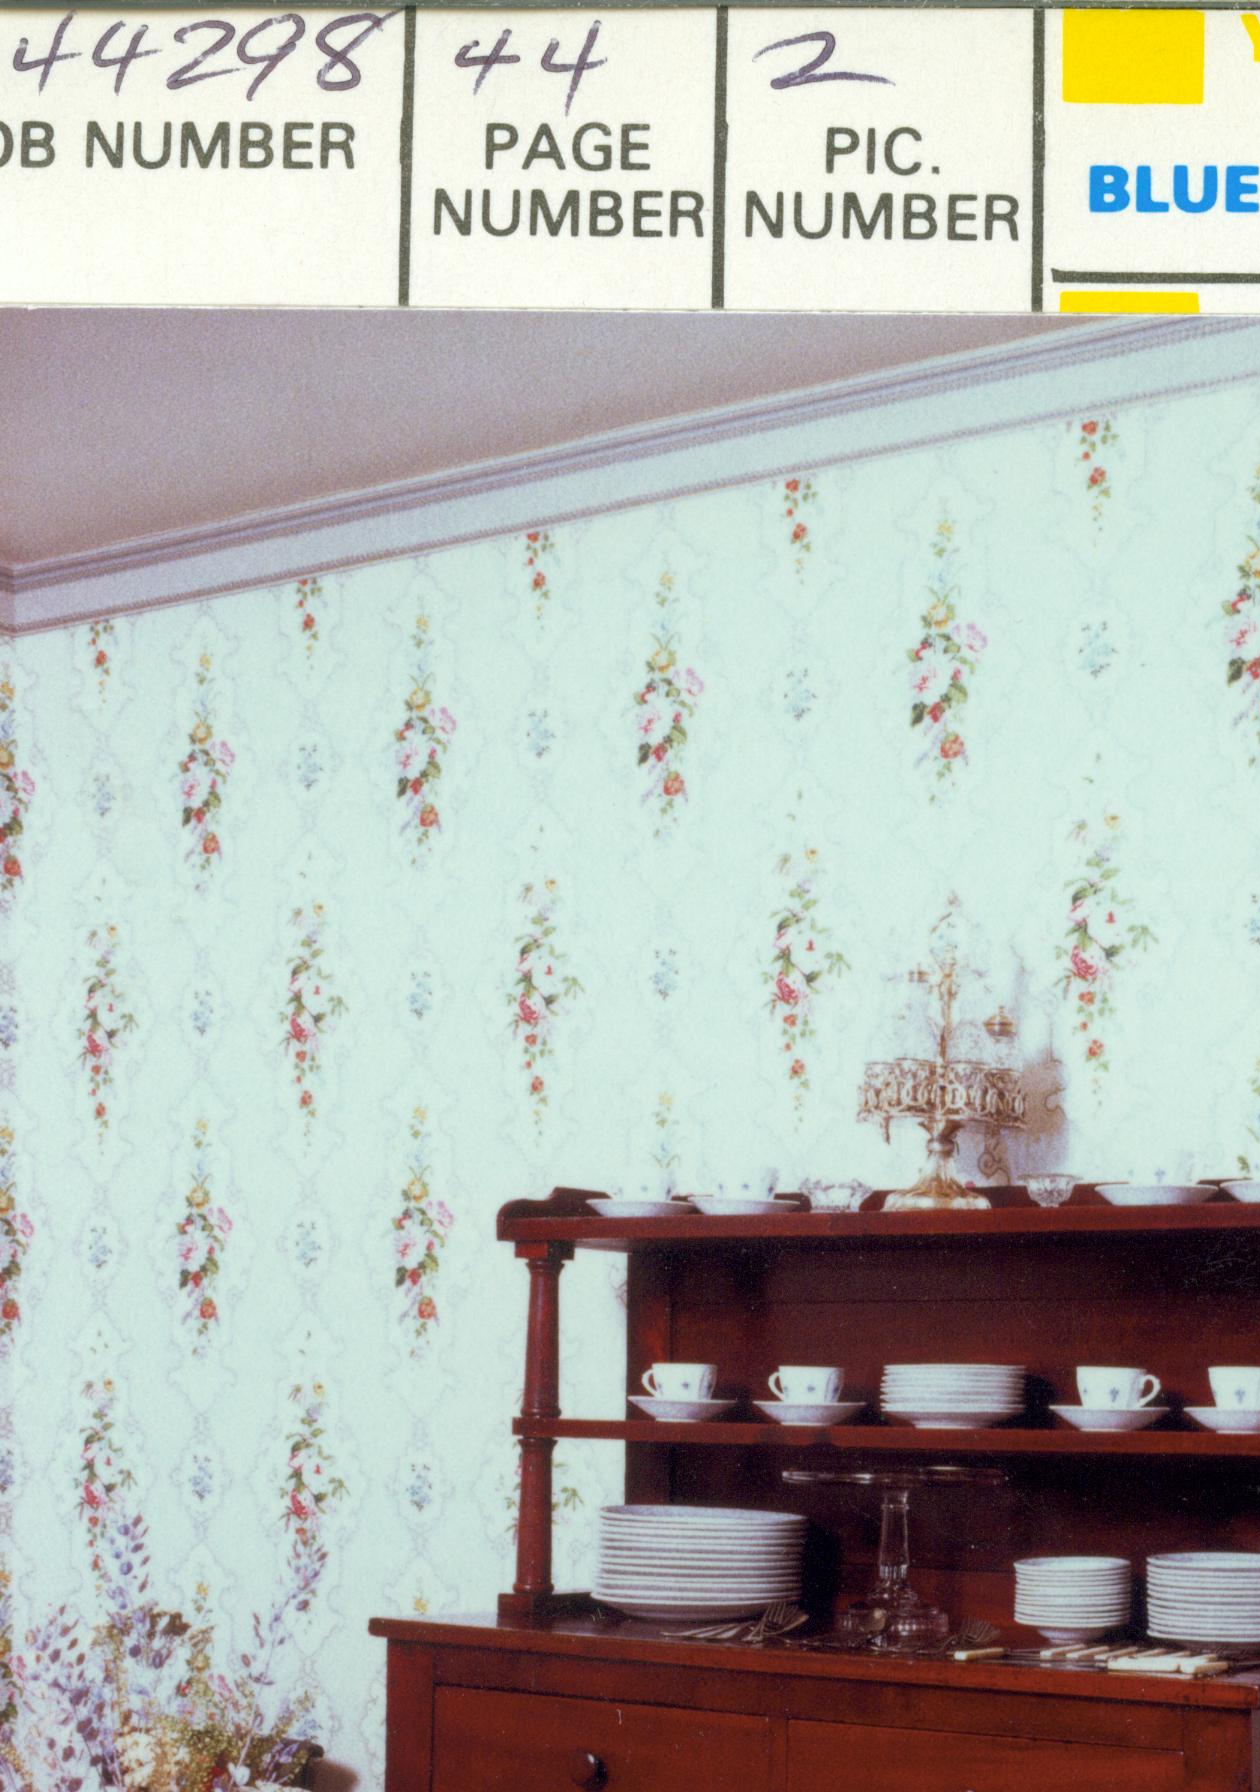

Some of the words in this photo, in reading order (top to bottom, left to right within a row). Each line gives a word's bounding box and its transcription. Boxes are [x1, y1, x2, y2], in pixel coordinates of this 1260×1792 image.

[12, 9, 406, 102] 44298
[454, 21, 606, 116] 44
[753, 31, 896, 90] 2
[85, 120, 356, 170] NUMBER
[485, 122, 651, 171] PAGE
[825, 127, 940, 176] PIC.
[433, 188, 704, 238] NUMBER
[1089, 164, 1260, 214] BLUE
[745, 190, 1020, 241] NUMBER
